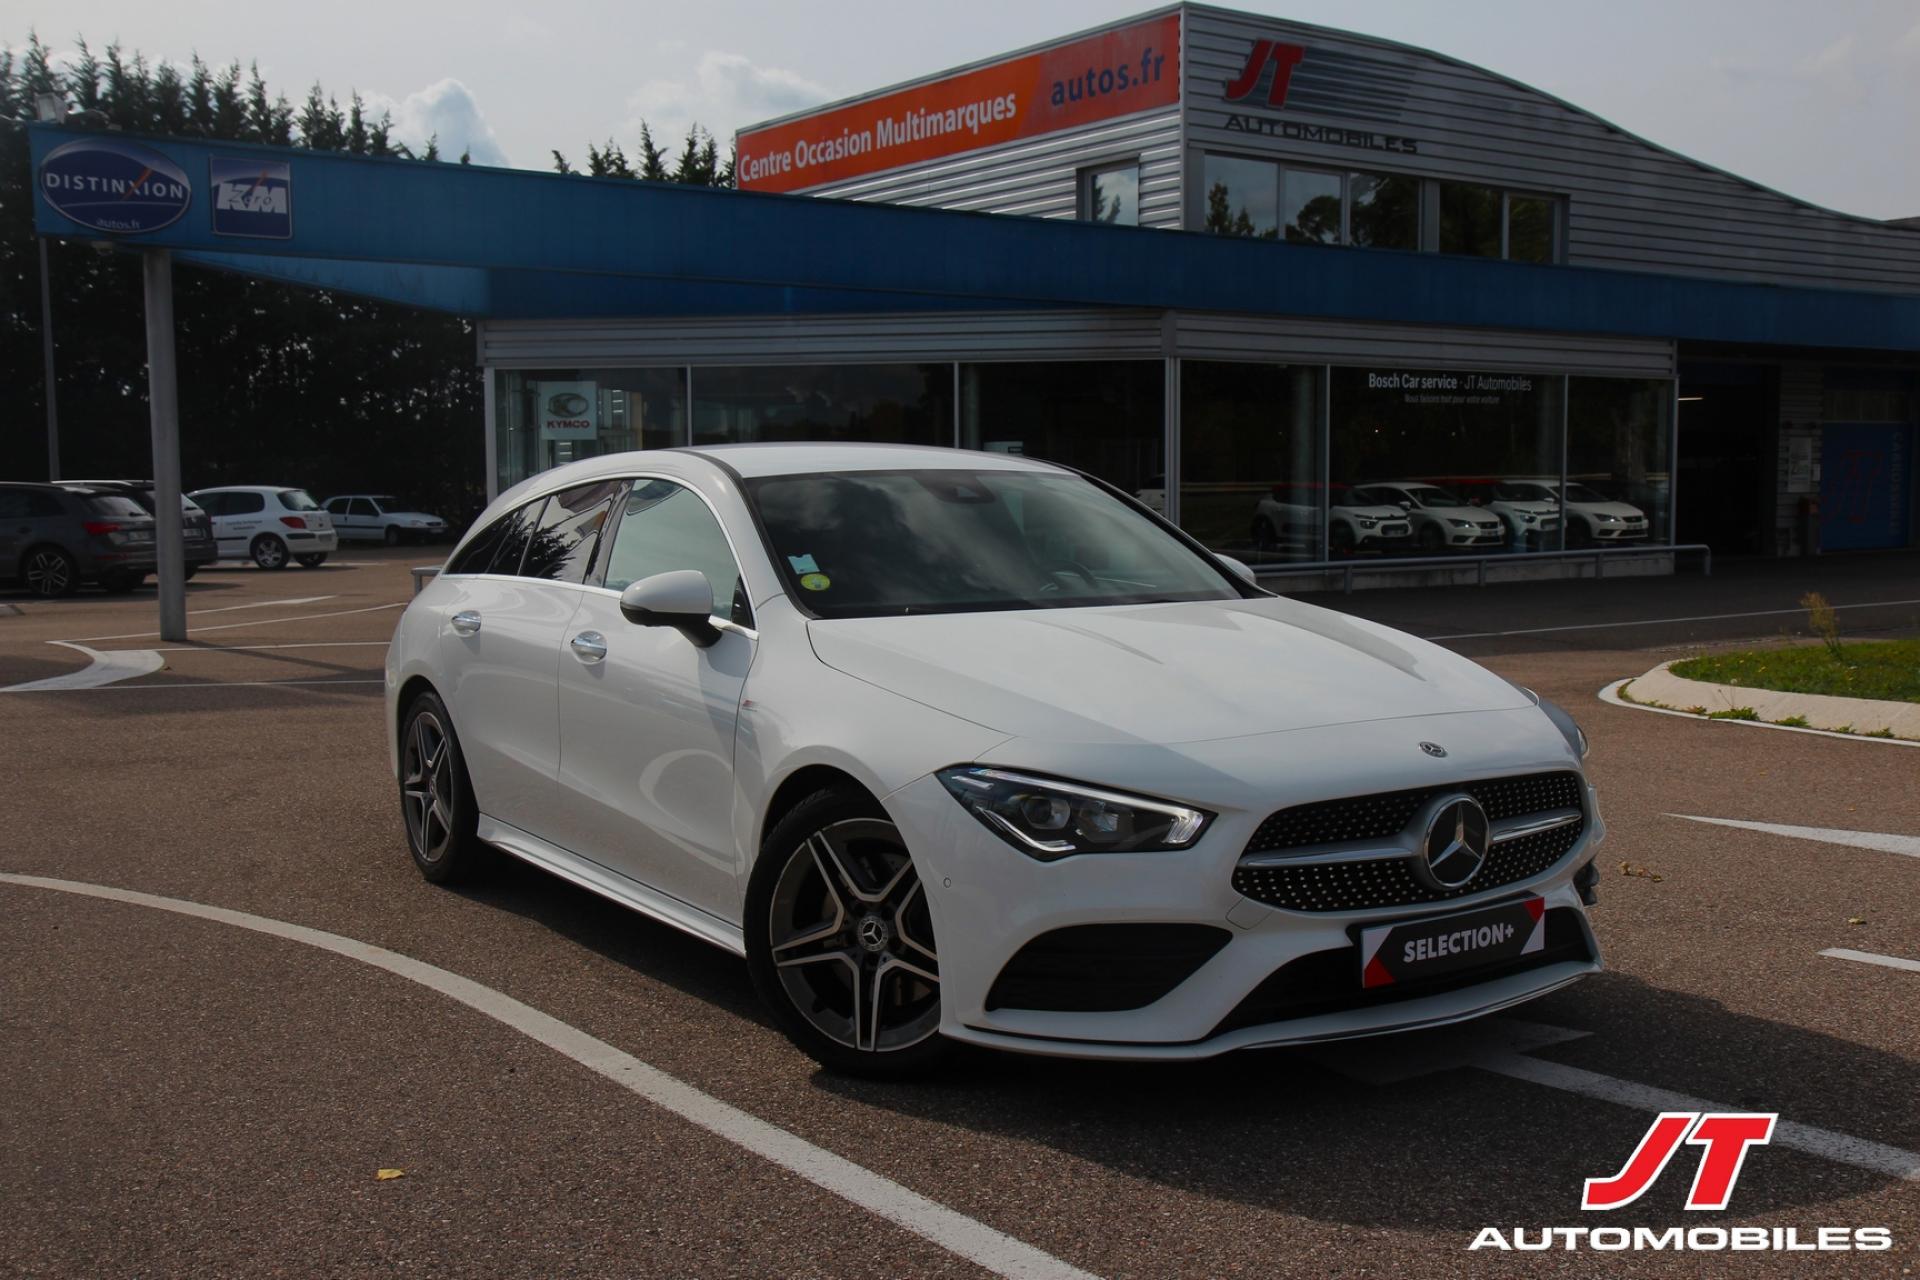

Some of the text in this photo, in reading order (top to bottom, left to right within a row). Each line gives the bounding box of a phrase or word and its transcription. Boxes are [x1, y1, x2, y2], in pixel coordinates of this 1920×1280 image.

[1052, 48, 1164, 106] autos.fr
[1224, 38, 1306, 109] JT
[740, 91, 1017, 182] Centre Occasion Multimarques
[1225, 114, 1417, 154] AUTOMOBILES
[45, 173, 184, 201] DISTINXION
[1368, 372, 1533, 392] Bosch Car service JT Automobiles
[546, 420, 590, 430] KYMCO
[1402, 923, 1515, 963] SELECTION+
